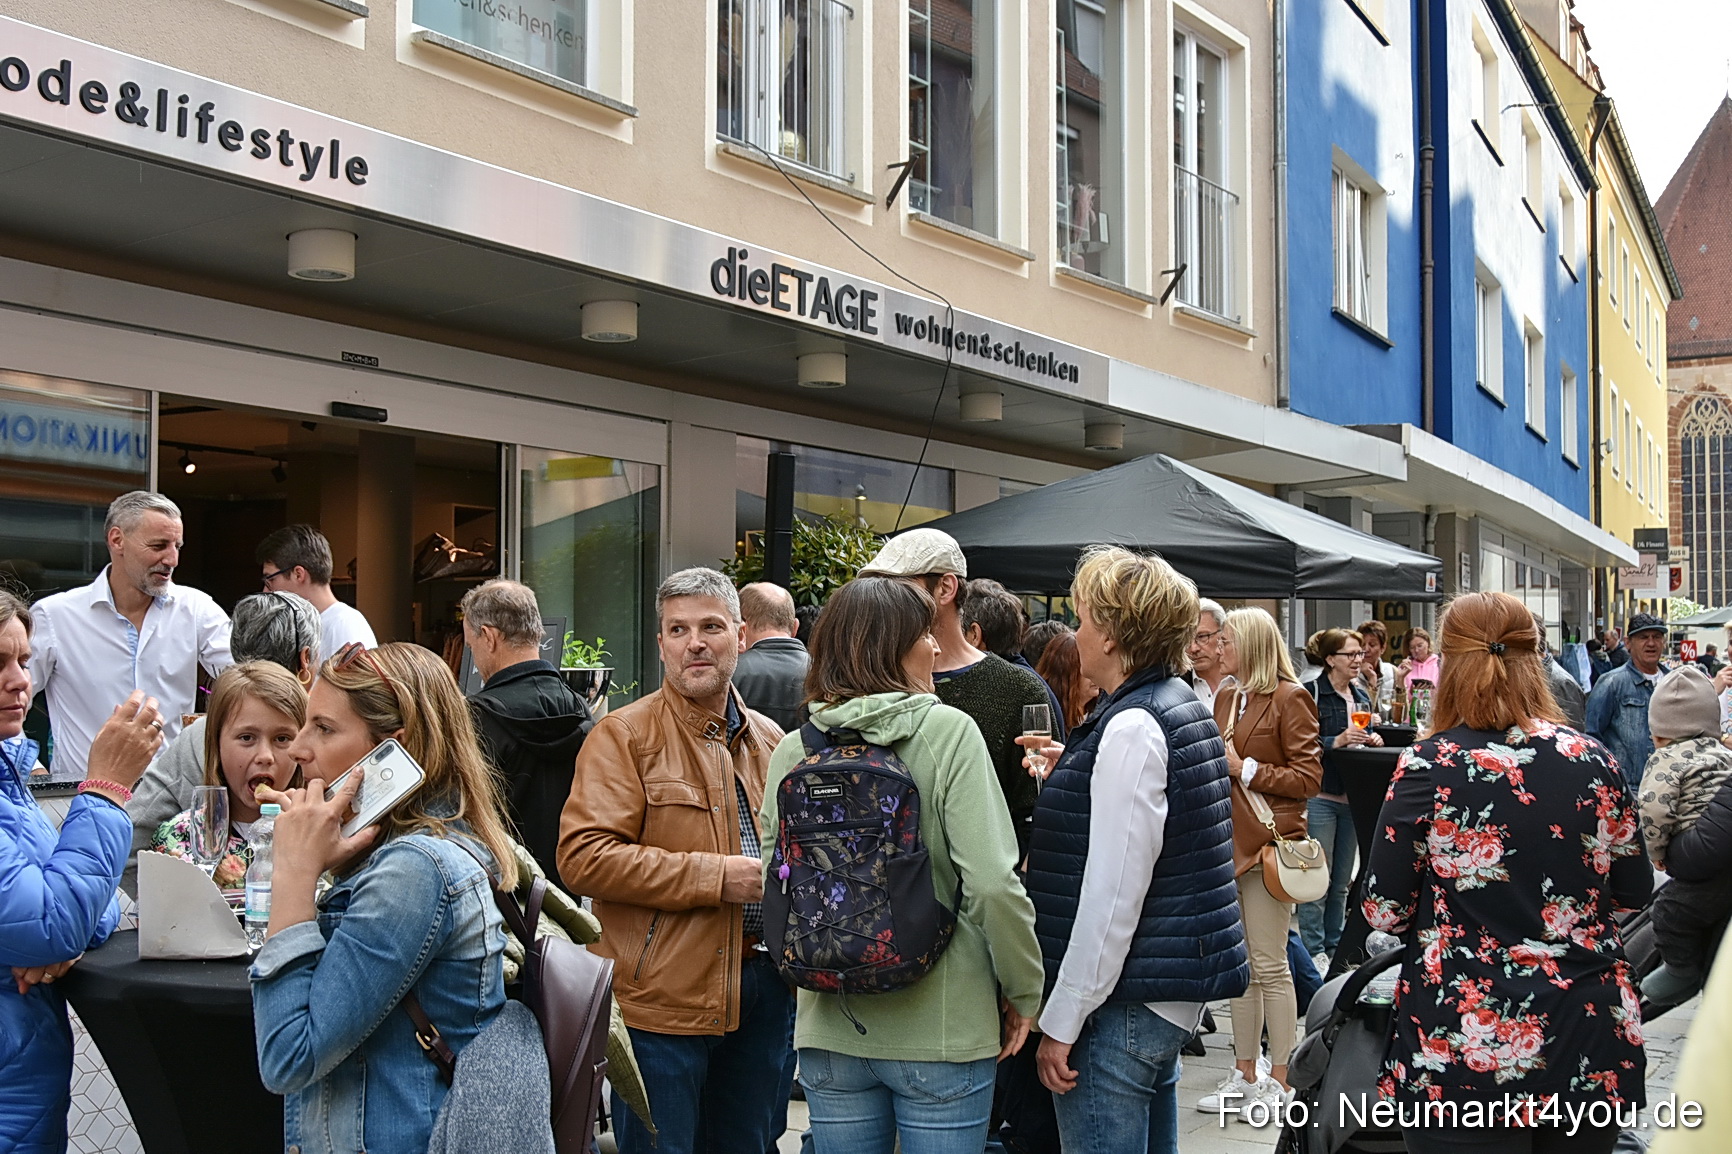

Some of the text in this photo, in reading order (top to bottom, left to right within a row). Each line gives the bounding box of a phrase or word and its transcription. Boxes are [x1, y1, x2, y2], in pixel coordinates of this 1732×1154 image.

[0, 56, 369, 185] ode&lifestyle
[711, 247, 878, 335] dieETAGE
[895, 312, 1079, 383] wohnen&schenken
[1681, 642, 1696, 660] %
